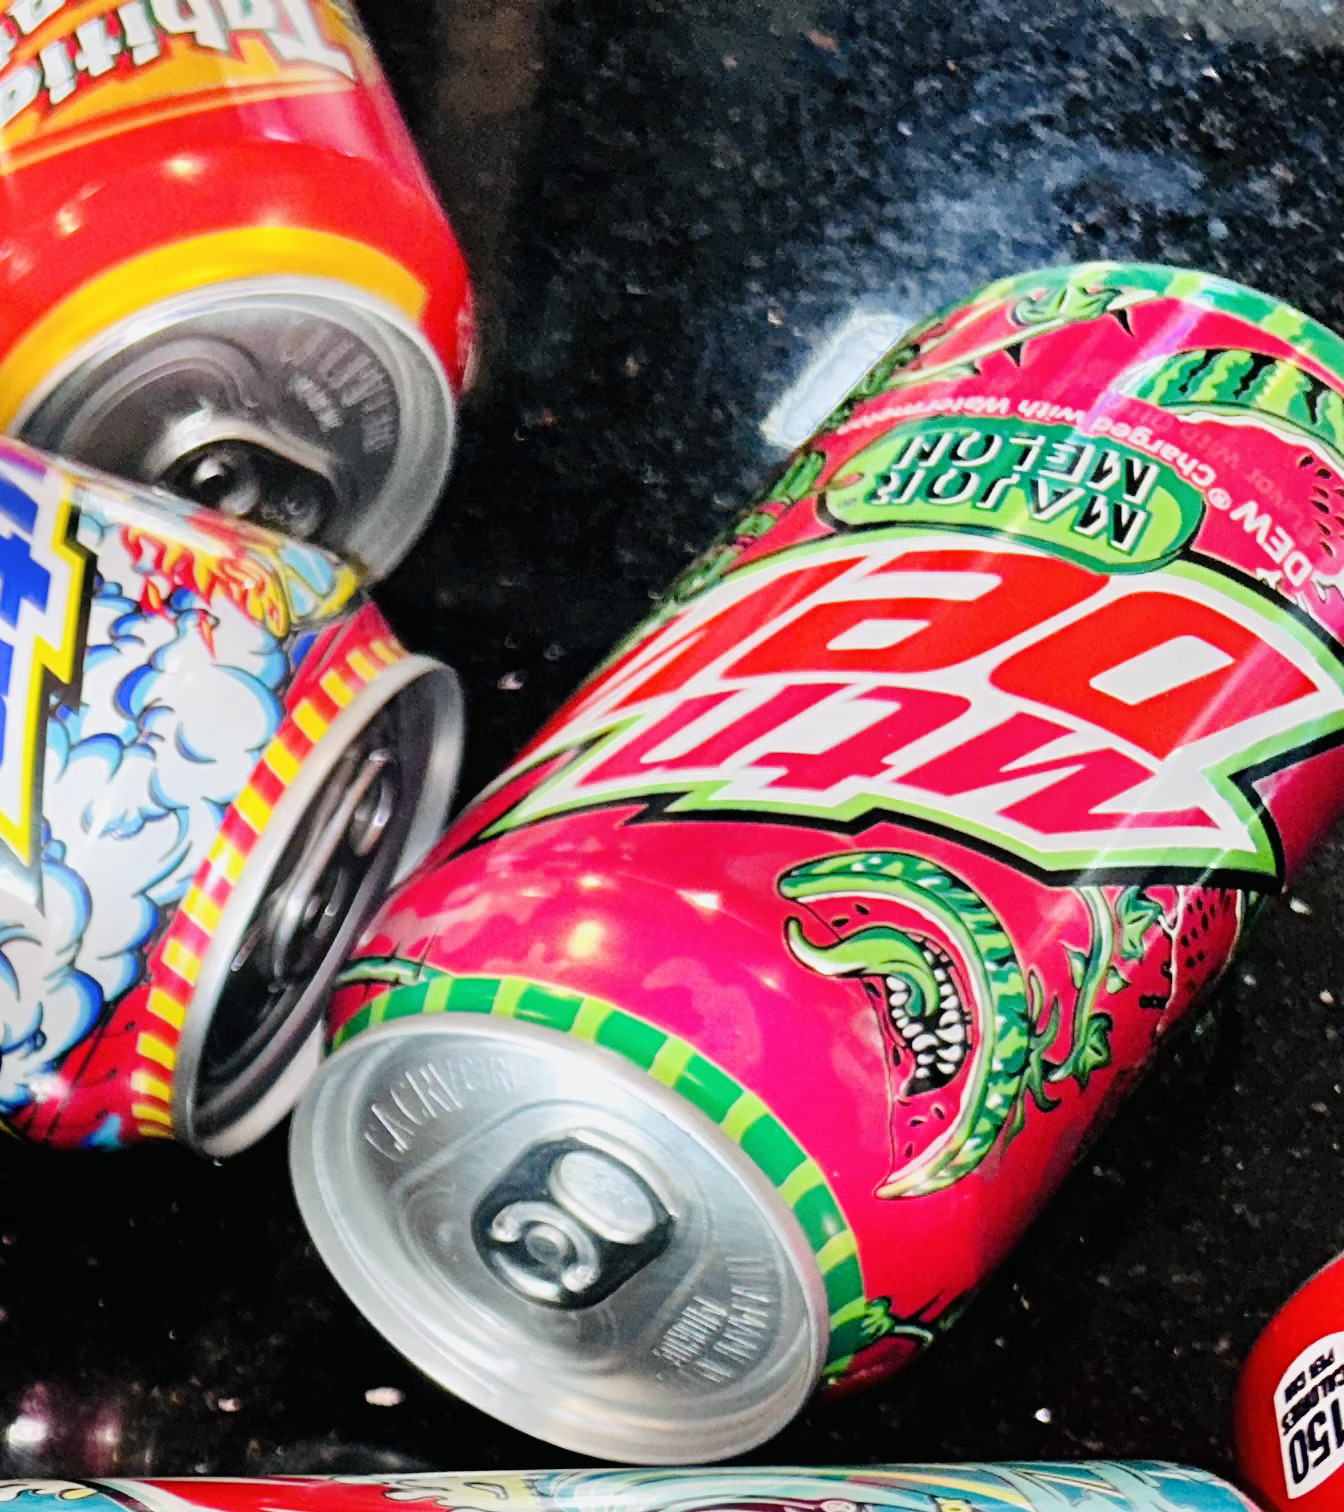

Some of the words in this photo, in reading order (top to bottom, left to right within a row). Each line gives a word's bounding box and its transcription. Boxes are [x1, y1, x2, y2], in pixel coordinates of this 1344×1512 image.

[1017, 399, 1083, 428] with
[892, 430, 1160, 506] MELON
[872, 466, 1156, 556] MAJOR
[1230, 500, 1312, 588] DEW
